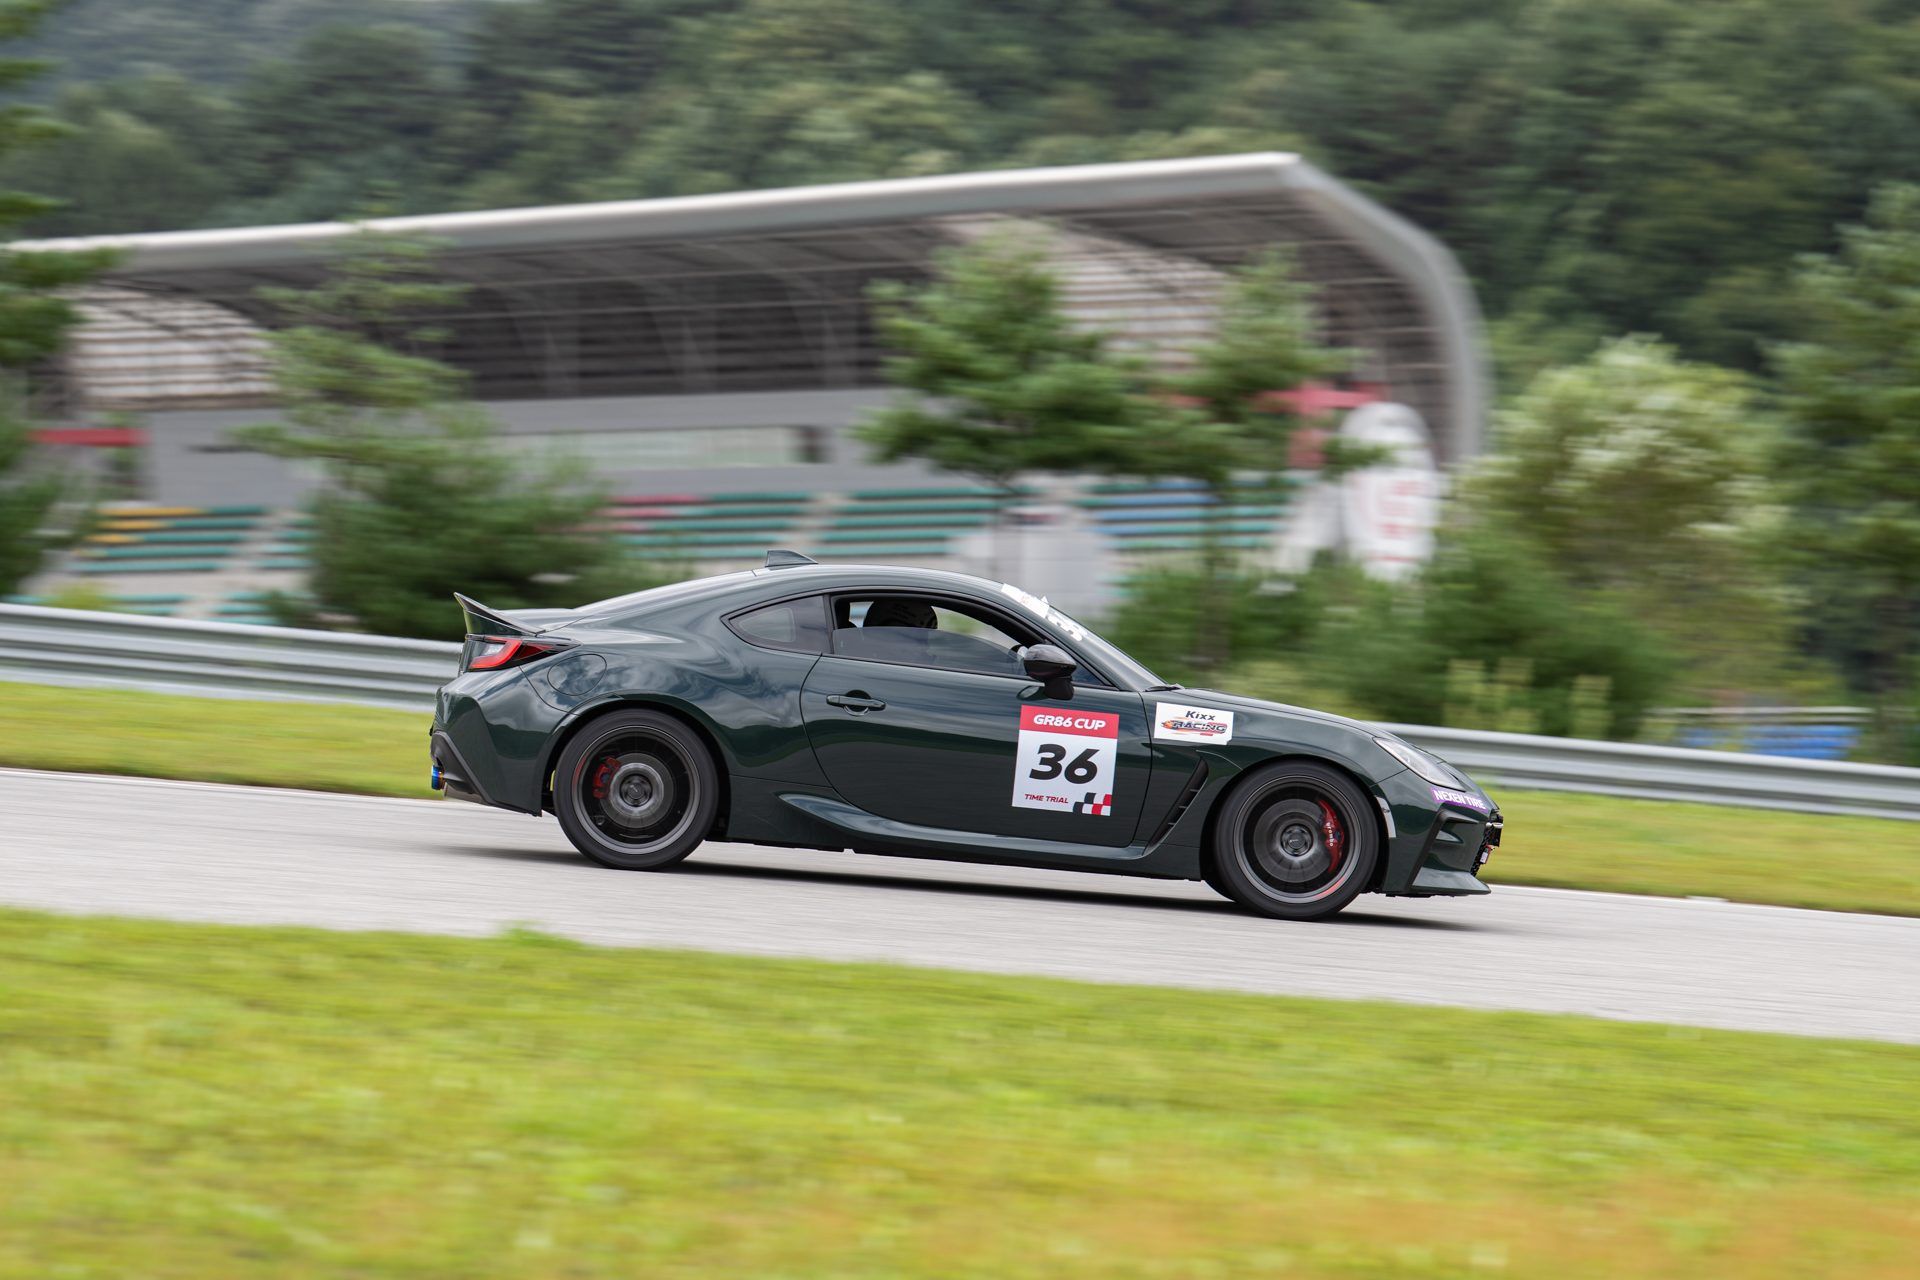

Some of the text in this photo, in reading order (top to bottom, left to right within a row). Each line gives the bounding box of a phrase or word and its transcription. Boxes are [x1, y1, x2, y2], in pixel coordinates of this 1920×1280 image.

[1033, 714, 1107, 730] GR86 CUP
[1185, 710, 1216, 721] Kixx
[1029, 743, 1100, 785] 36
[1024, 793, 1069, 804] TIME TRIAL
[1433, 790, 1486, 809] NEXEN TIRE
